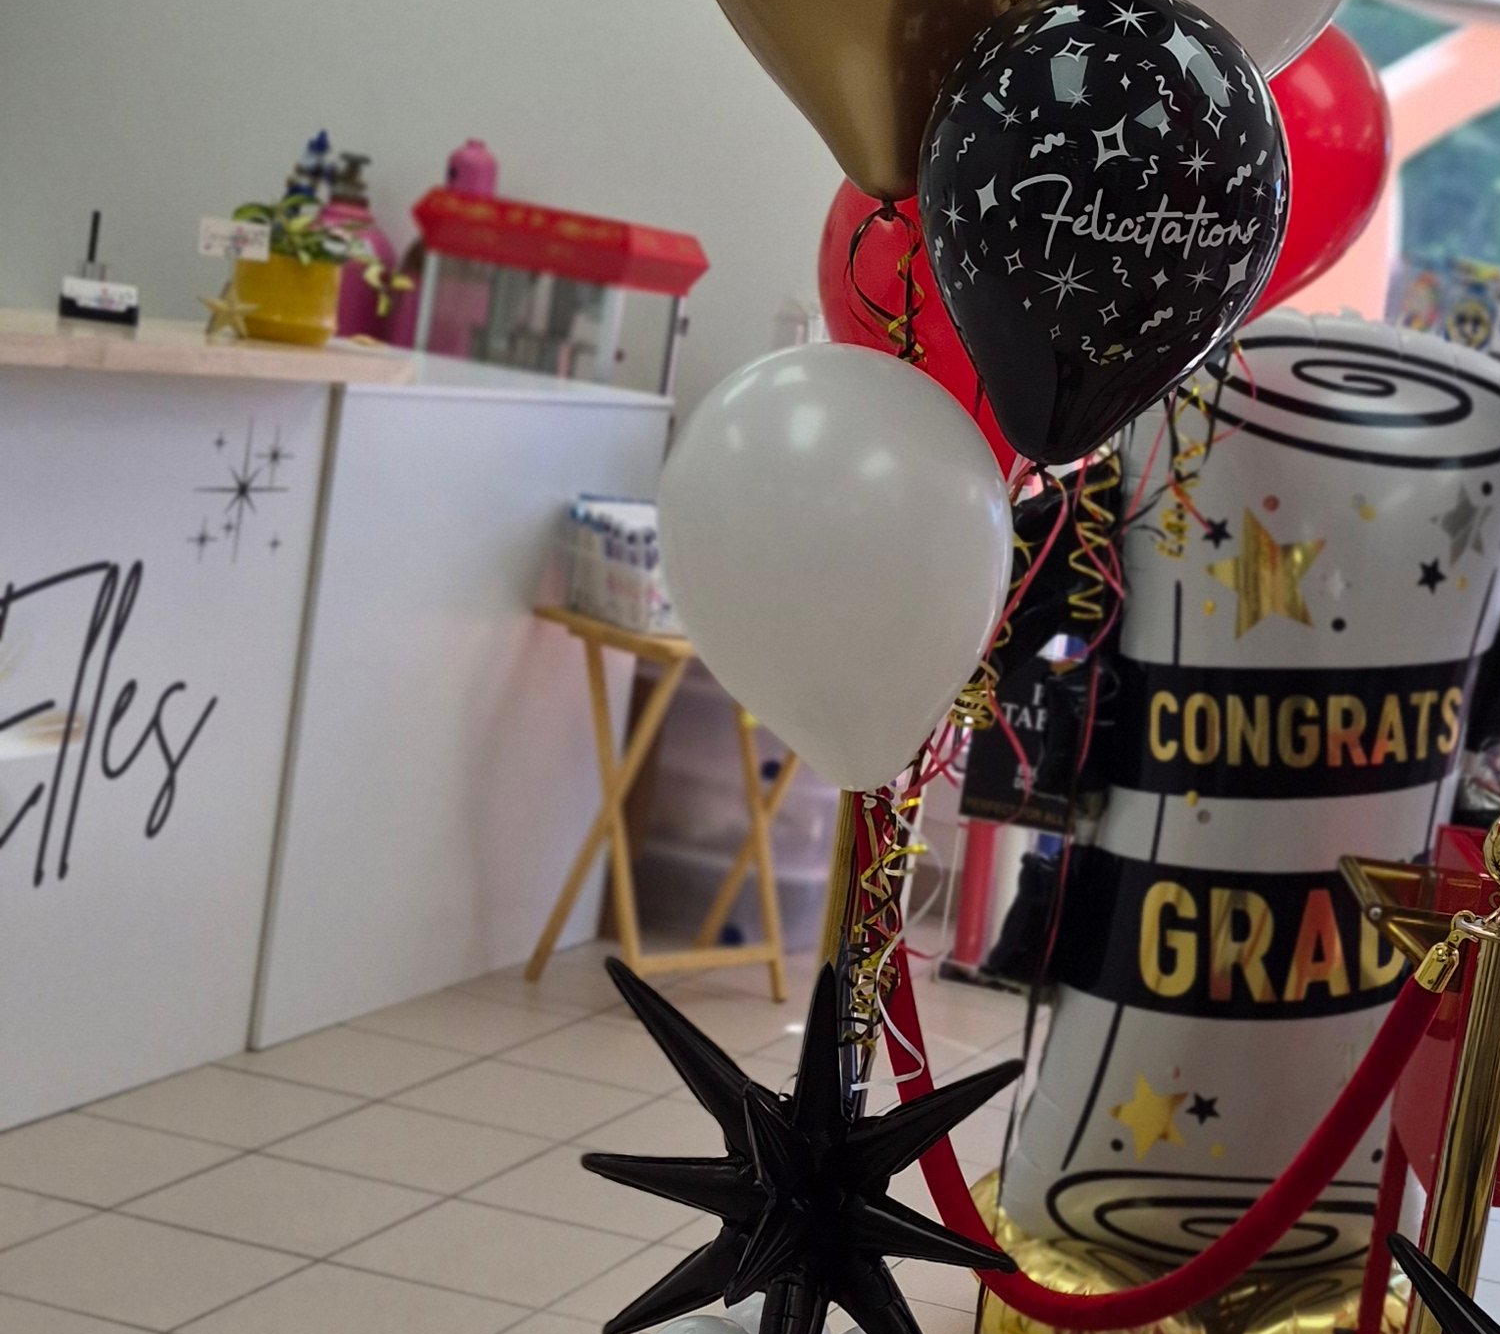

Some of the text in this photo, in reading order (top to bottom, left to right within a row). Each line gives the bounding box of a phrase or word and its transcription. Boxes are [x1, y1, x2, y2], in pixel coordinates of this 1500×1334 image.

[1011, 174, 1261, 260] Félicitations
[1150, 686, 1464, 769] CONGRATS
[1139, 880, 1407, 1002] GRAD
